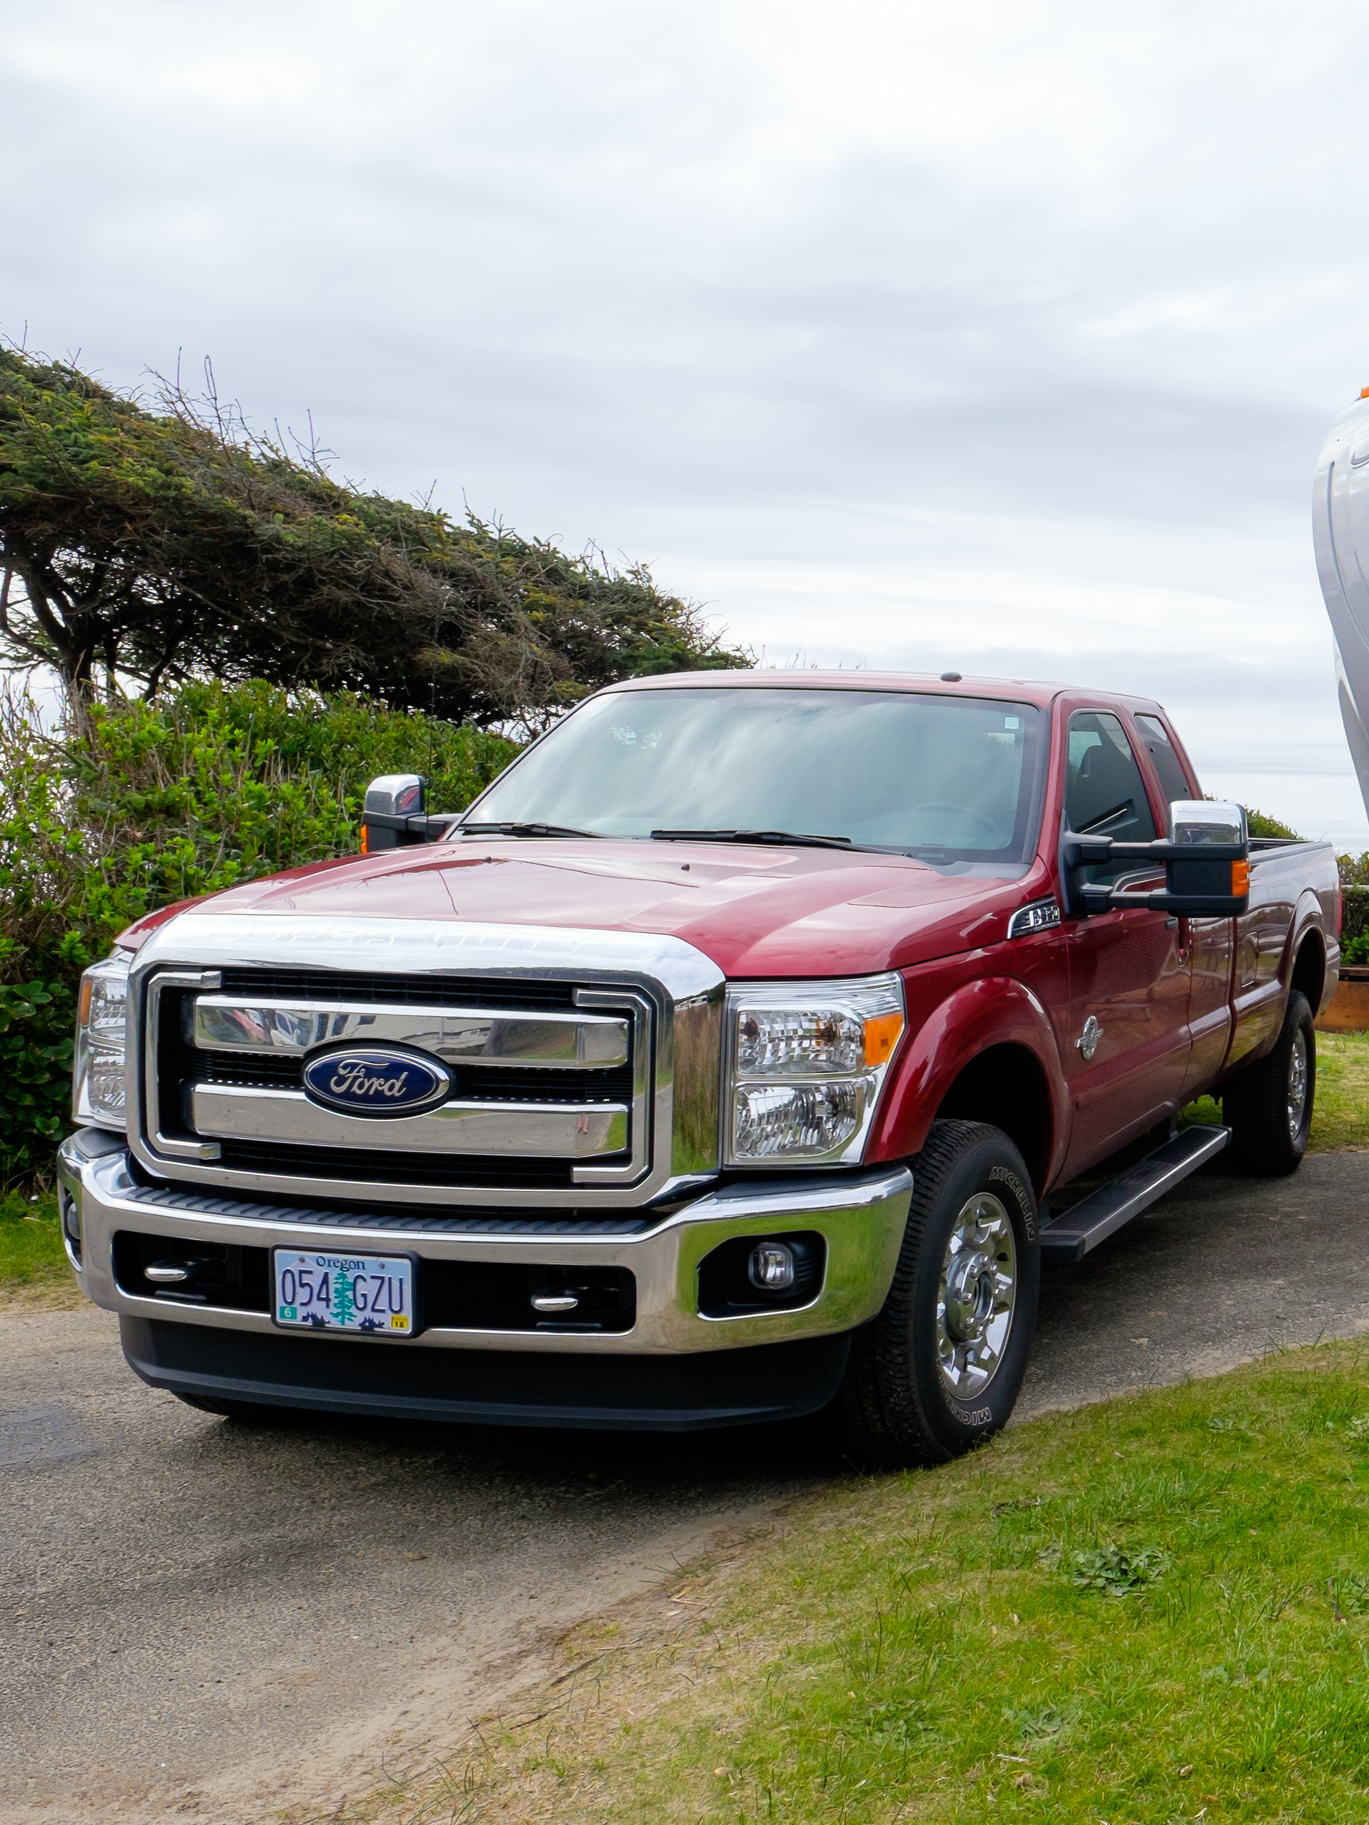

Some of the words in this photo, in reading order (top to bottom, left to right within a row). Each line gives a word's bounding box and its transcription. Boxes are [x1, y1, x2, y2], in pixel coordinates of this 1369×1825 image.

[209, 920, 399, 946] SUPER
[424, 928, 600, 954] DUTY
[330, 1059, 409, 1097] Ford
[988, 1166, 1036, 1242] MICHELIN
[316, 1255, 367, 1273] Oregon
[281, 1267, 332, 1309] 054
[352, 1273, 404, 1315] GZU
[284, 1307, 293, 1318] 6
